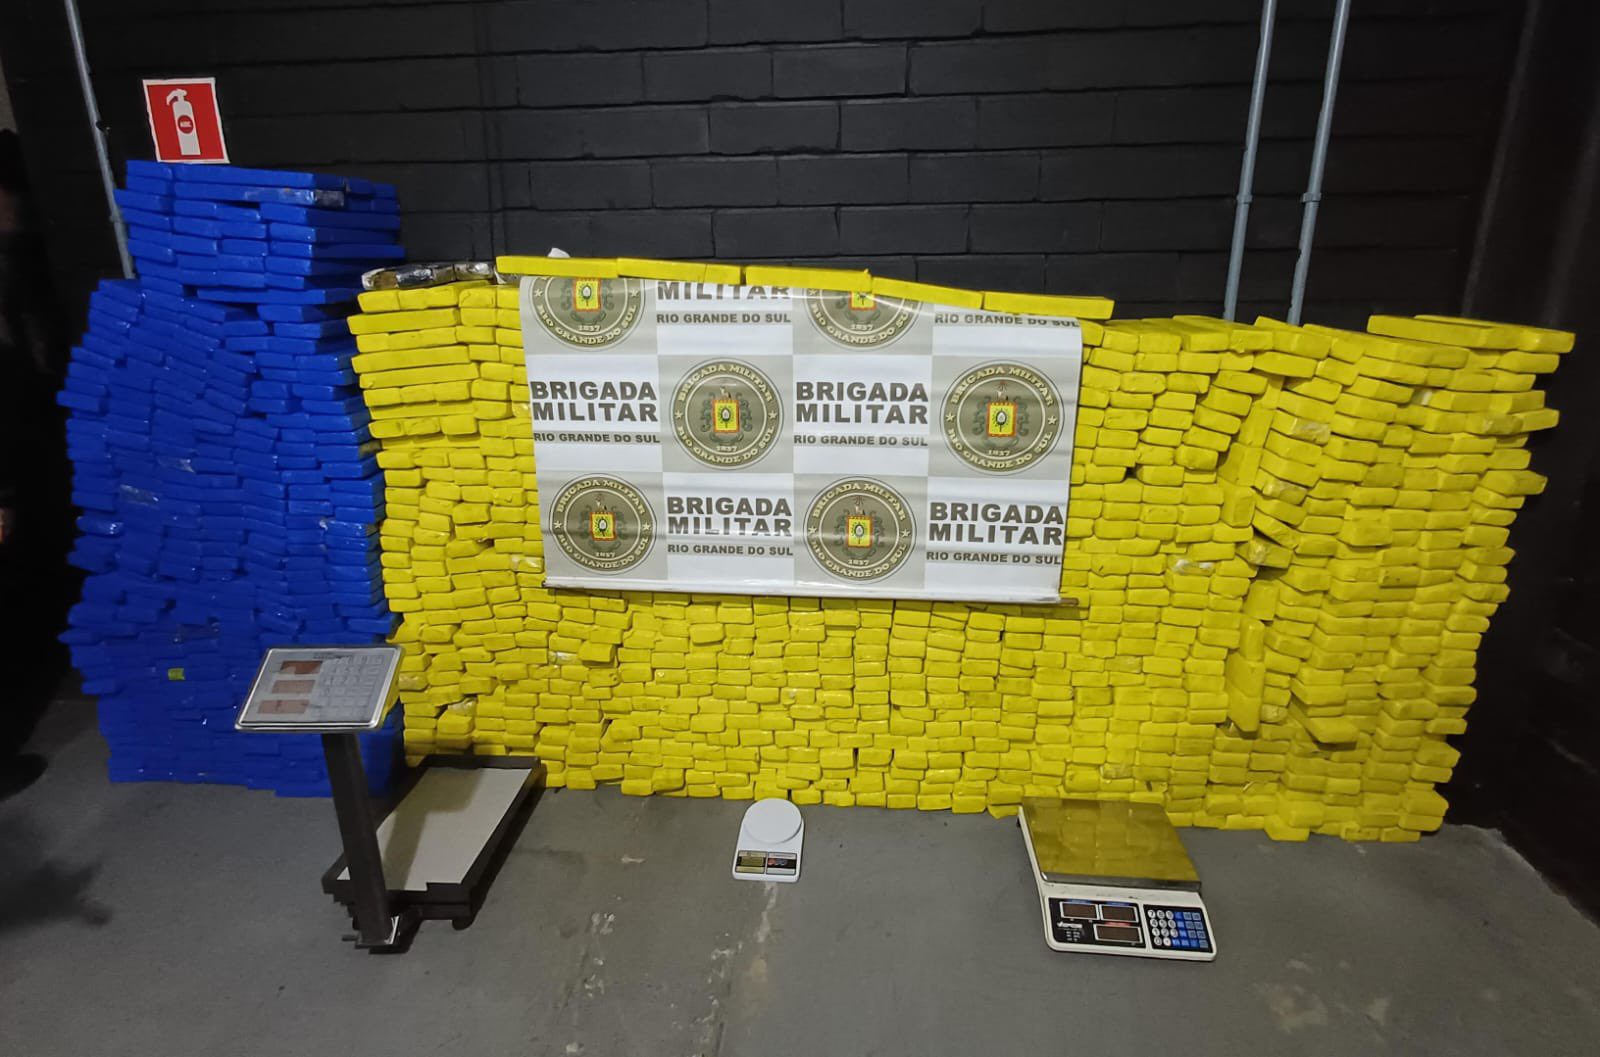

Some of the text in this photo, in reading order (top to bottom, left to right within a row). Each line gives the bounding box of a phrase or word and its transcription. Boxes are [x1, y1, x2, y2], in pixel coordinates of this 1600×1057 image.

[657, 281, 791, 300] MILITAR
[537, 304, 636, 345] RIO GRANDE DO SUL
[656, 314, 791, 324] RIO GRANDE DO SUL
[811, 303, 826, 326] RIO
[827, 326, 877, 344] GRANDE
[879, 326, 894, 340] DO
[935, 314, 1080, 328] RIO GRANDE DO SUL
[530, 381, 657, 400] BRIGADA
[678, 364, 773, 402] BRIGADA MILITAR
[796, 381, 928, 402] BRIGADA
[951, 366, 1054, 408] BRIGADA MILITAR
[533, 402, 658, 422] MILITAR
[796, 403, 928, 424] MILITAR
[534, 432, 660, 444] RIO GRANDE DO SUL
[678, 426, 774, 464] RIO GRANDE DO SUL
[794, 435, 928, 446] RIO GRANDE DO SUL
[948, 428, 1053, 468] RIO GRANDE DO SUL
[557, 480, 646, 514] BRIGADA MILITAR
[667, 496, 792, 517] BRIGADA
[812, 482, 906, 520] BRIGADA MILITAR
[930, 502, 1064, 524] BRIGADA
[668, 517, 792, 536] MILITAR
[929, 523, 1062, 546] MILITAR
[558, 534, 649, 568] RIO GRANDE DO SUL
[668, 544, 794, 556] RIO GRANDE DO SUL
[811, 540, 907, 578] RIO GRANDE DO SUL
[926, 551, 1062, 564] RIO GRANDE DO SUL
